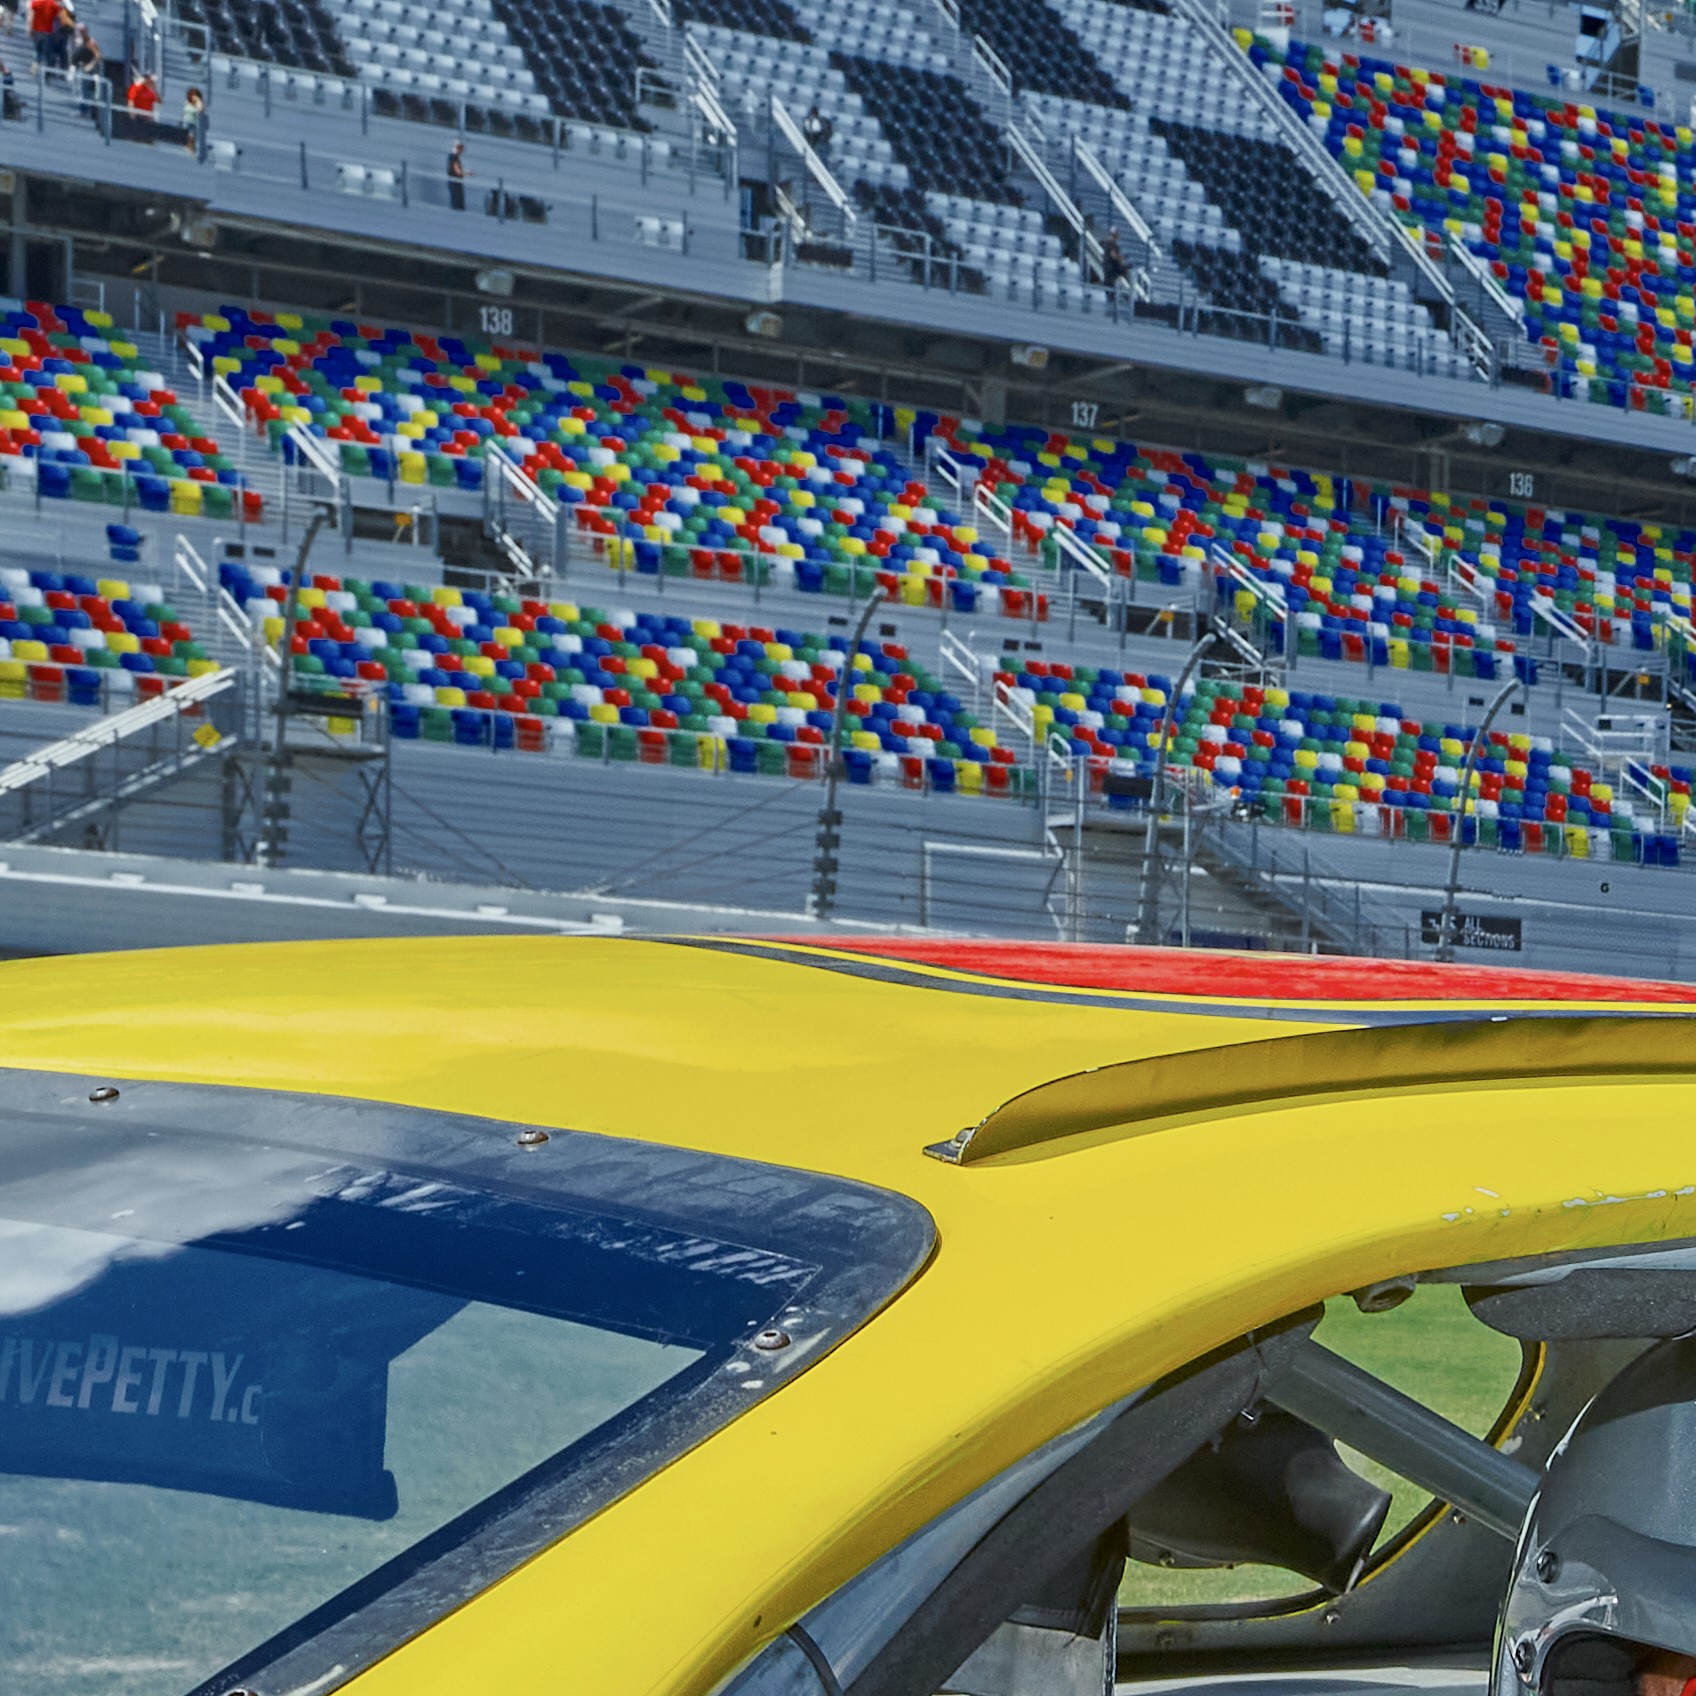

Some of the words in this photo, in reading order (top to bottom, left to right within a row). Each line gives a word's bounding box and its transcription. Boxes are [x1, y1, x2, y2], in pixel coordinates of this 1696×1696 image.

[479, 306, 513, 336] 138
[1071, 400, 1098, 428] 137
[1509, 472, 1534, 497] 136
[1464, 916, 1482, 930] ALL
[1463, 931, 1516, 950] SECTIONS
